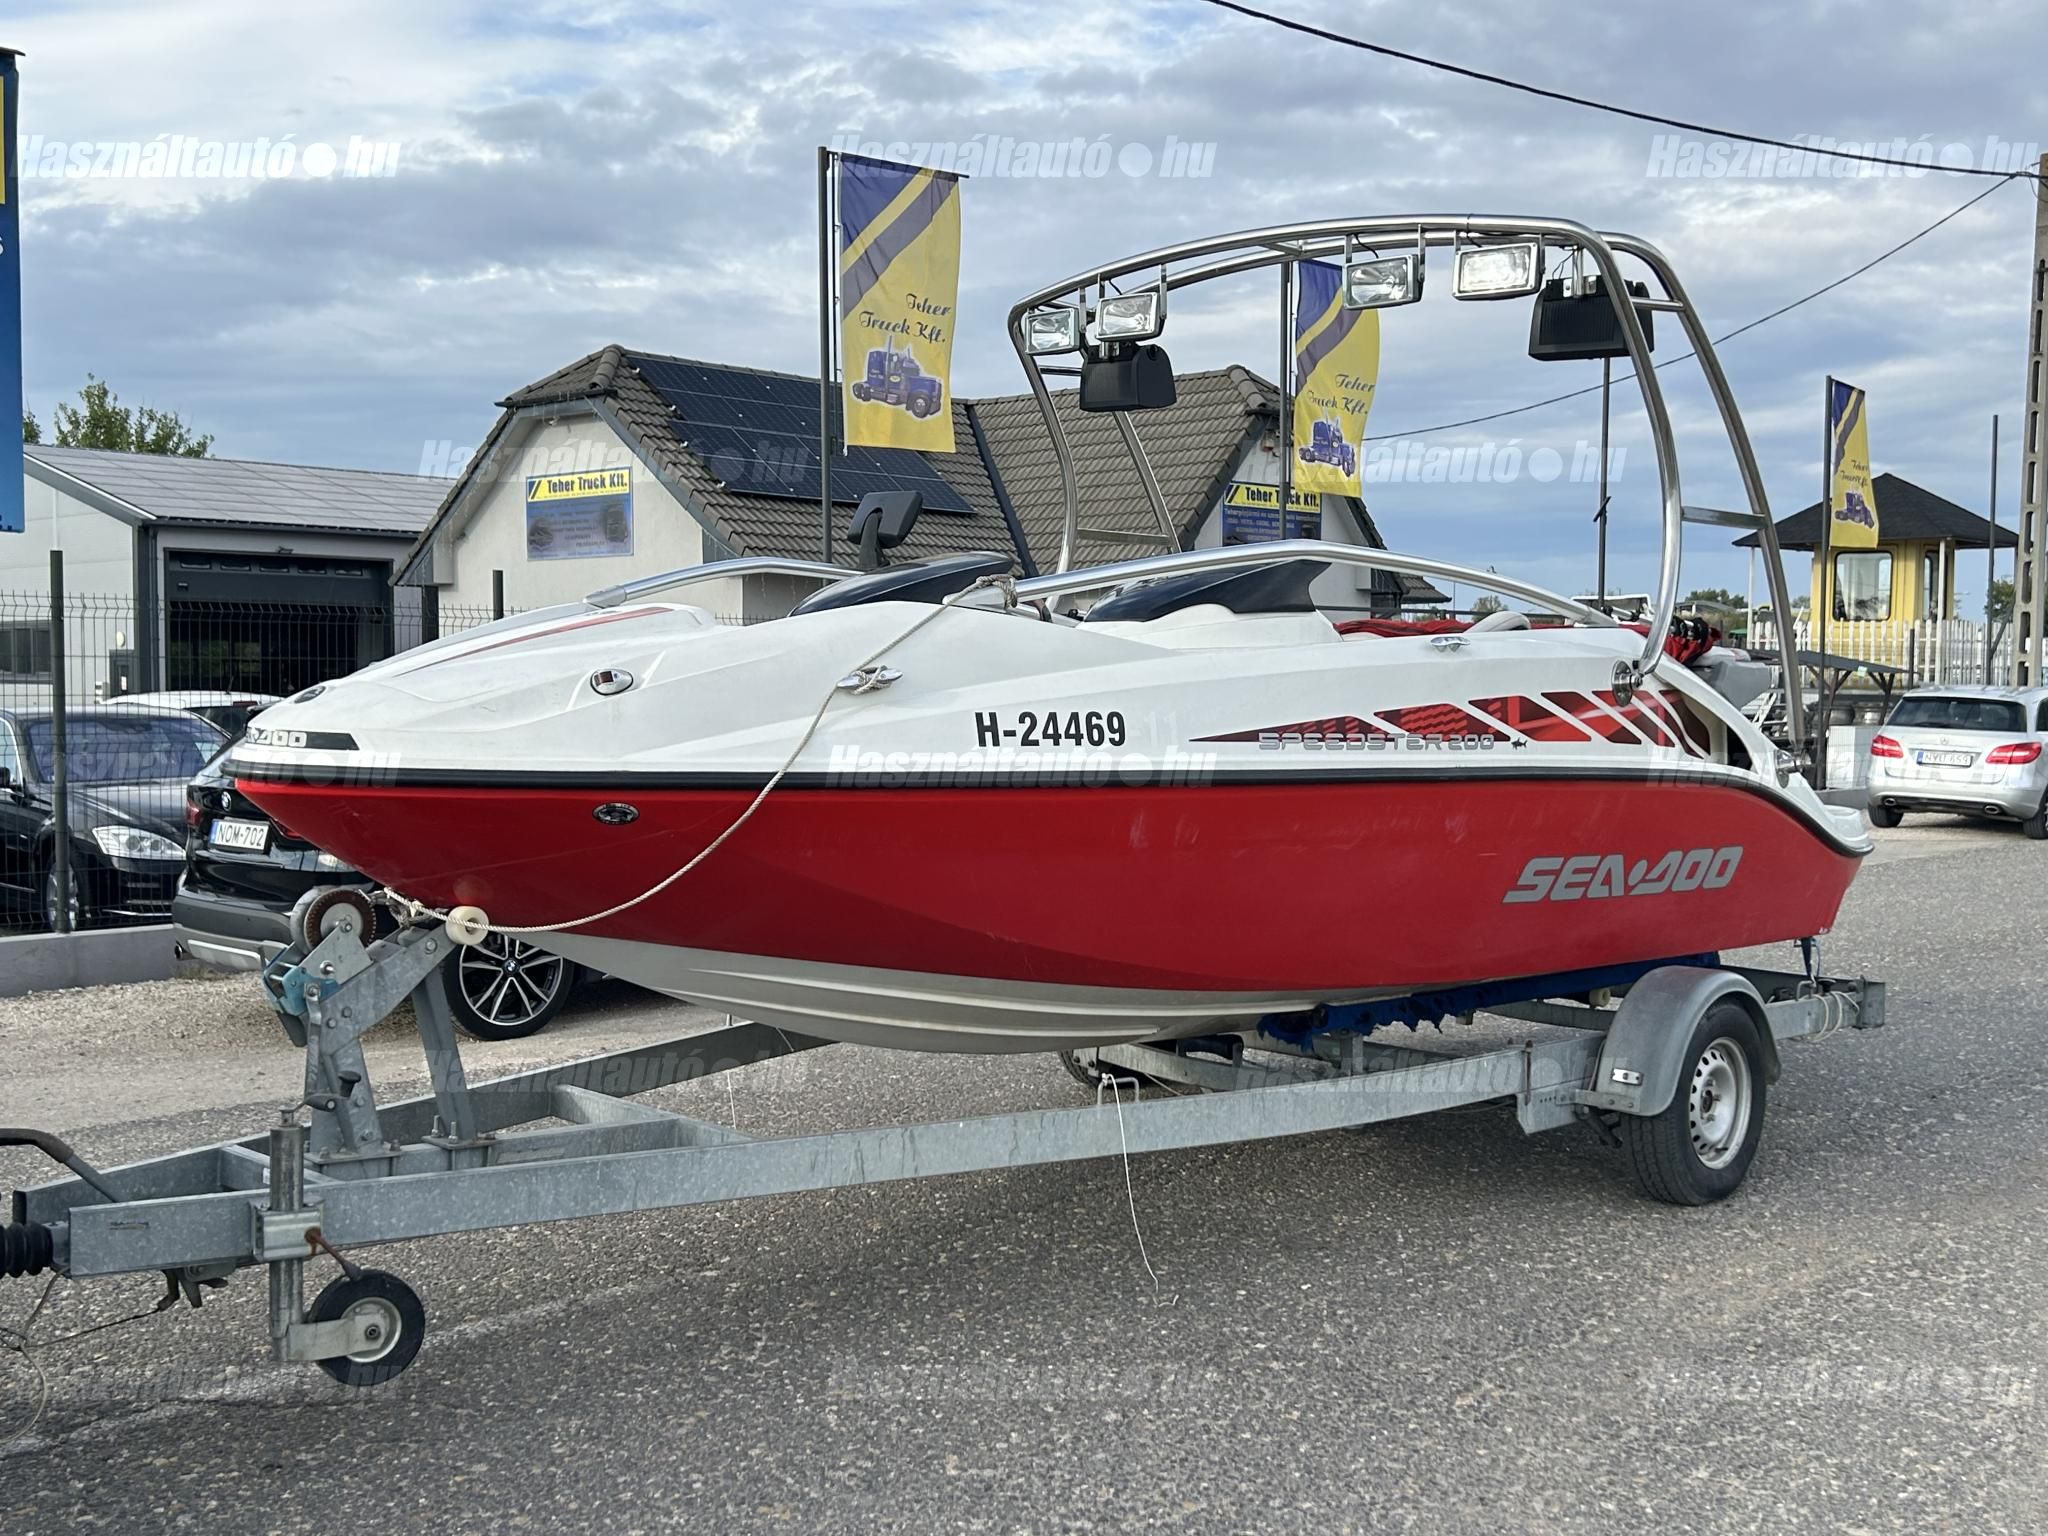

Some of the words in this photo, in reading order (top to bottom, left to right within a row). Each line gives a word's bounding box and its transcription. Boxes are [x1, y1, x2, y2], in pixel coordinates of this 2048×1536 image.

[906, 293, 951, 316] Teher
[859, 310, 910, 335] Truck
[913, 321, 946, 343] Kft.
[1335, 373, 1375, 393] Teher
[546, 479, 575, 494] Teher
[577, 475, 606, 491] Truck
[1245, 487, 1273, 503] Teher
[1275, 489, 1301, 505] Tck
[975, 711, 1126, 747] H-24469
[1258, 732, 1443, 750] SPEEDSTER
[1447, 734, 1495, 750] 200
[218, 825, 265, 847] NOM-702
